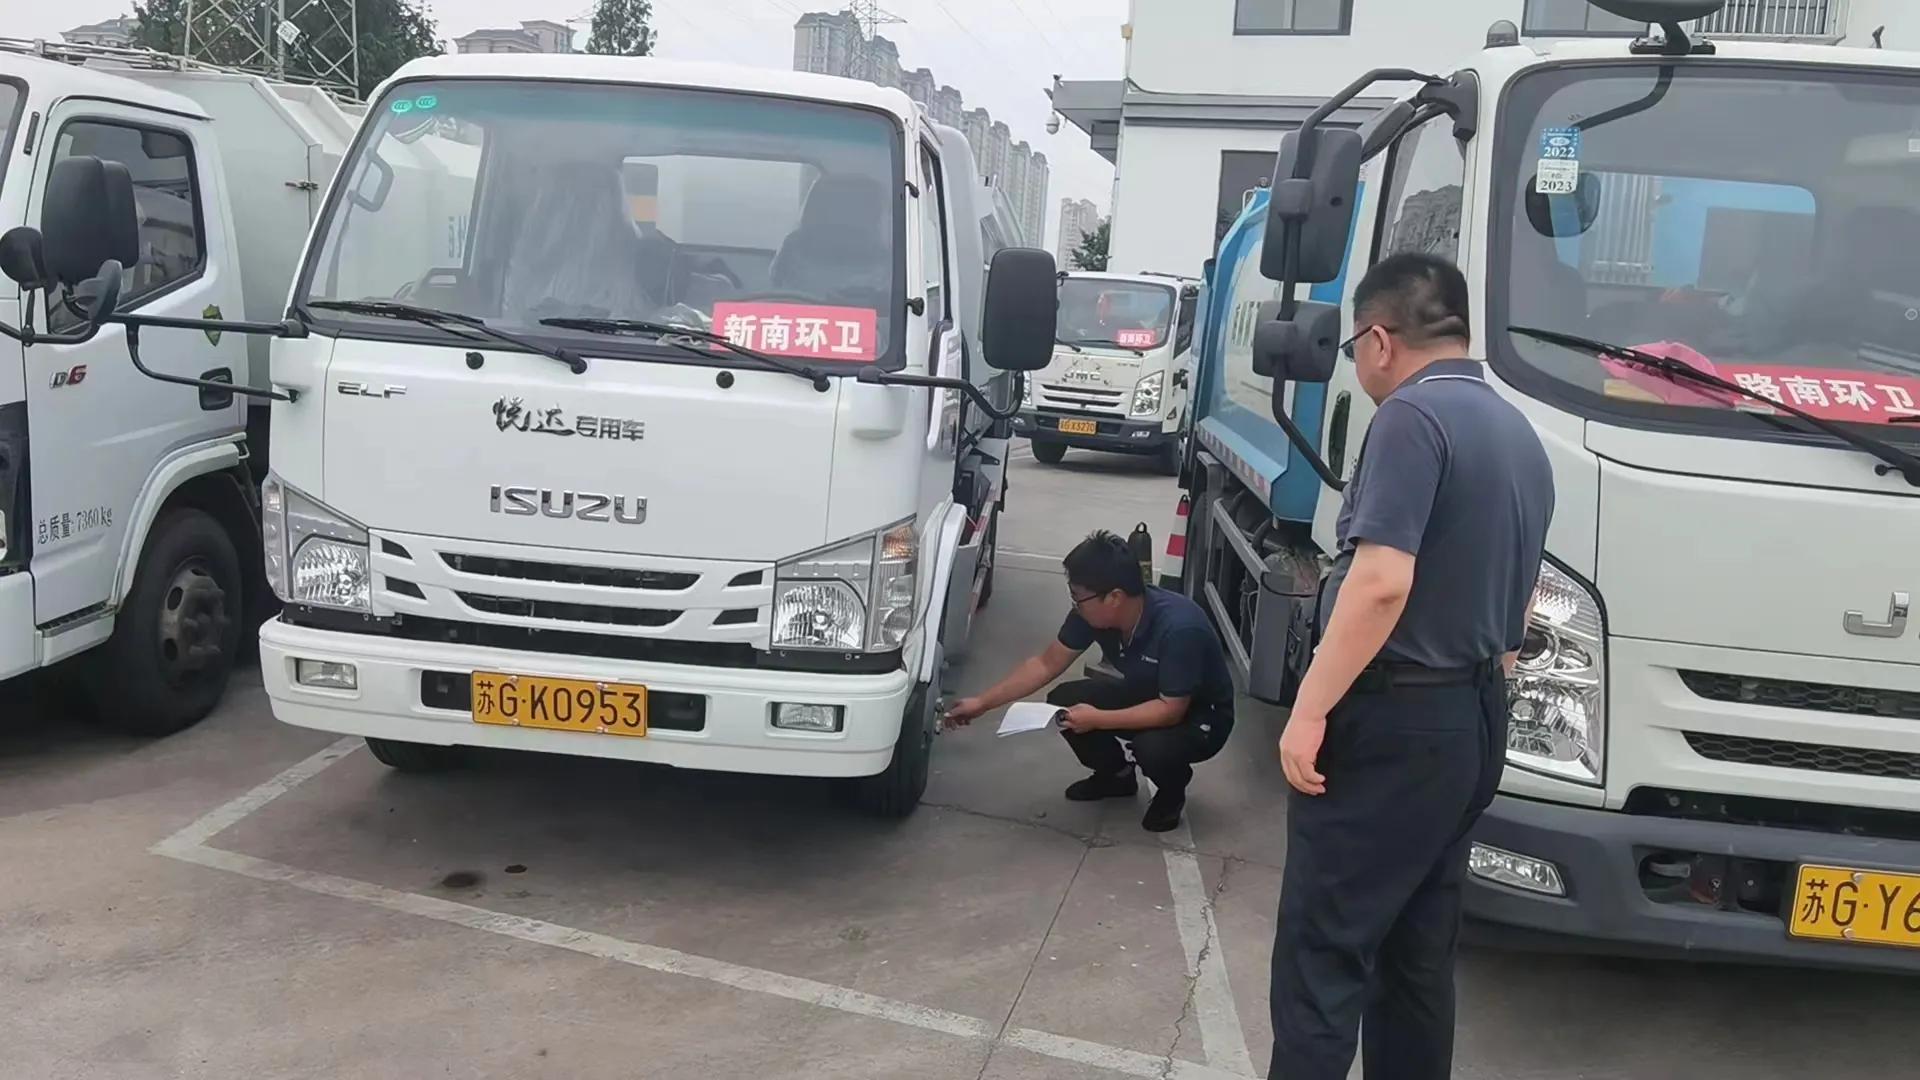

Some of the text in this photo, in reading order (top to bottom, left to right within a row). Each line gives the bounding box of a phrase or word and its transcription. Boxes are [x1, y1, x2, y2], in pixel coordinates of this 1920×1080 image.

[1543, 146, 1575, 158] 2022
[1540, 180, 1572, 192] 2023
[724, 313, 863, 354] 新南环卫
[1064, 369, 1101, 381] JMC
[337, 381, 407, 399] ELF
[1734, 373, 1920, 415] 路南环卫
[490, 484, 647, 524] ISUZU
[476, 680, 641, 728] 苏G·K0953
